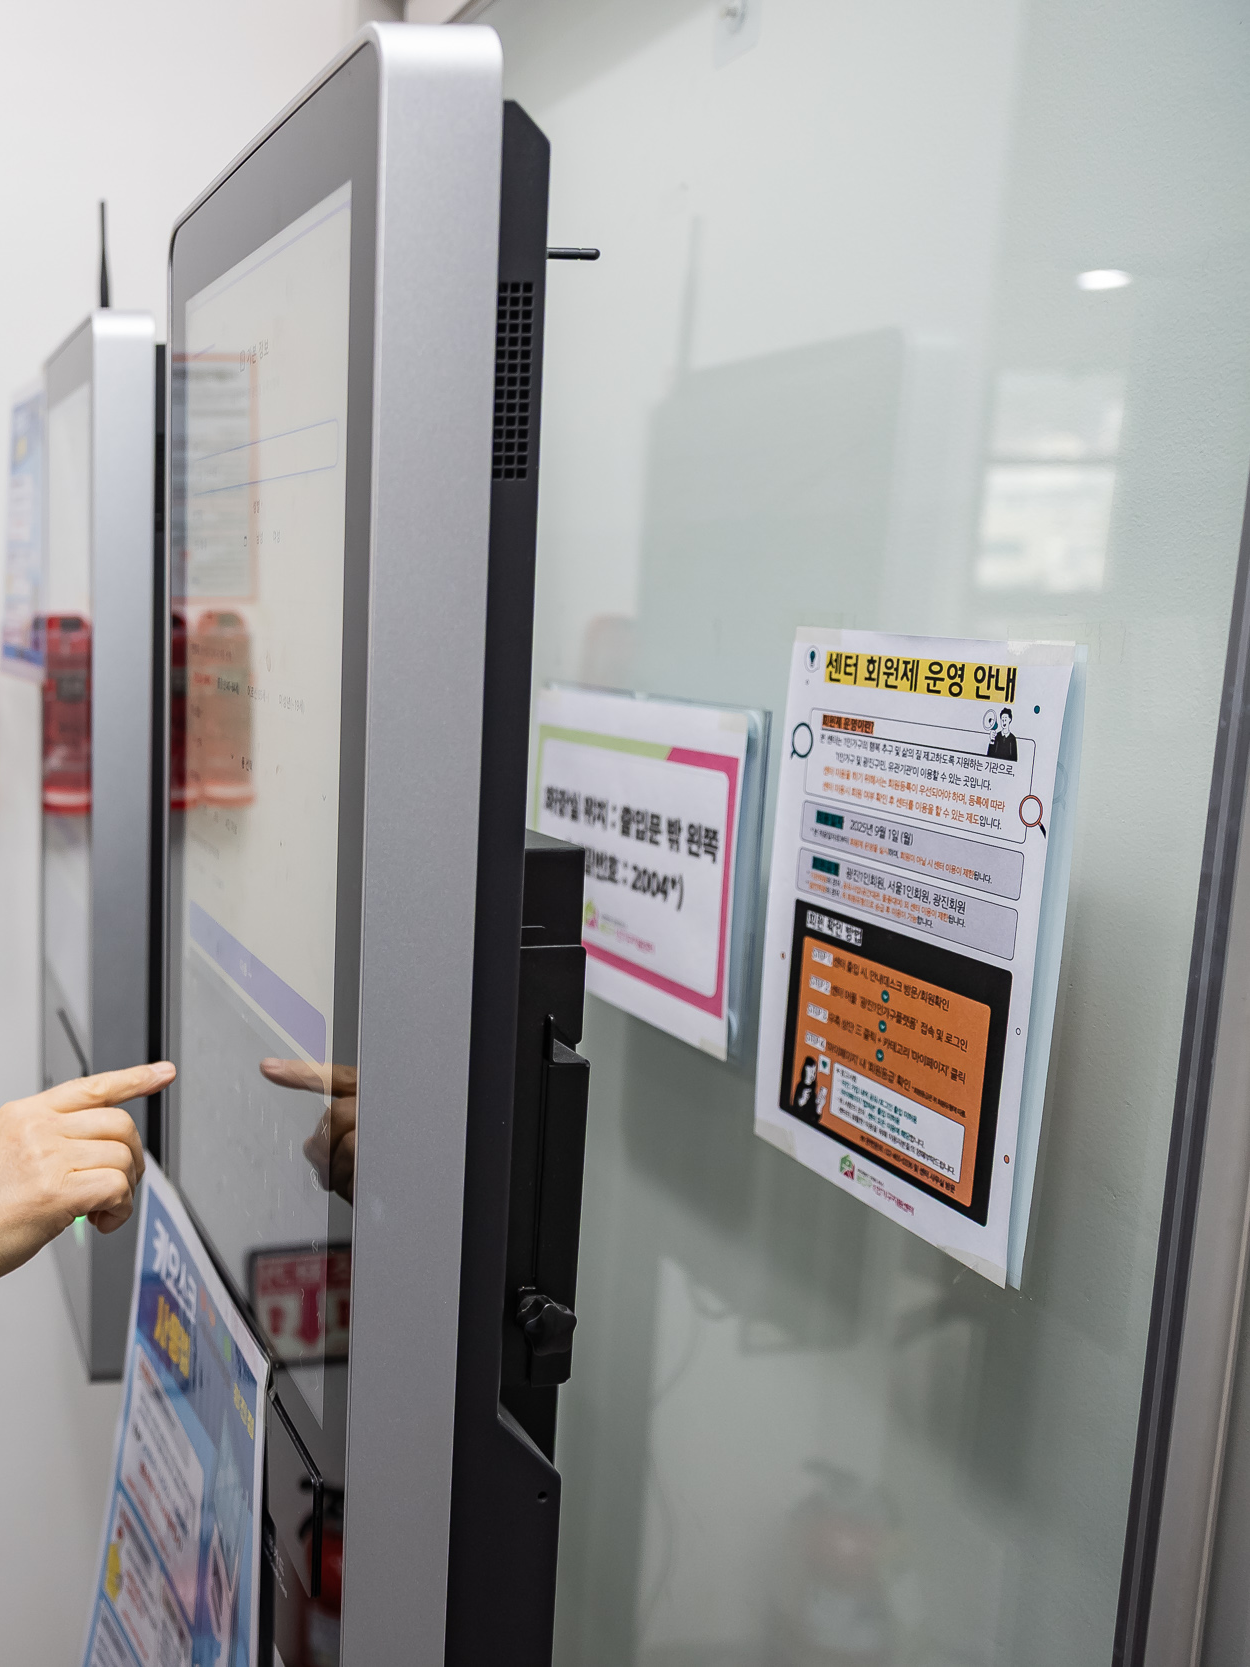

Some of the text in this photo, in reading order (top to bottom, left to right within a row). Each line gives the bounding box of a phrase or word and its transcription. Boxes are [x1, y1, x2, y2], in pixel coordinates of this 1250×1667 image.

[825, 651, 1017, 703] 센터 회원제 운영 안내
[855, 755, 861, 766] 및
[919, 767, 939, 781] 이용할
[939, 770, 947, 783] 수
[947, 772, 962, 786] 있는
[962, 774, 992, 792] 곳입니다.
[881, 743, 893, 755] 추구
[894, 745, 901, 757] 및
[901, 746, 914, 759] 삶의
[915, 748, 922, 760] 질
[922, 750, 955, 766] 제고하도록
[955, 755, 983, 771] 지원하는
[984, 760, 1015, 777] 기관으로,
[887, 777, 918, 794] 회원등록이
[918, 784, 951, 801] 우선되어야
[951, 790, 967, 805] 하며,
[967, 794, 989, 809] 등록에
[989, 798, 1005, 813] 따라
[584, 795, 609, 831] 위치
[620, 805, 662, 846] 출입문
[666, 816, 682, 852] 밖
[686, 822, 719, 863] 왼쪽
[895, 796, 914, 811] 센터를
[914, 800, 934, 815] 이용을
[934, 805, 941, 817] 할
[942, 806, 949, 819] 수
[950, 808, 964, 822] 있는
[965, 811, 1002, 831] 제도입니다.
[849, 818, 873, 836] 2025년
[873, 824, 886, 840] 9월
[887, 828, 899, 843] 1일
[900, 831, 913, 847] (월)
[845, 865, 886, 891] 광진1인회원,
[887, 878, 931, 905] 서울1인회원,
[932, 891, 966, 915] 광진회원
[933, 859, 944, 872] 센터
[945, 863, 962, 876] 이용이
[962, 867, 992, 885] 제한됩니다.
[869, 969, 902, 992] 안내데스크
[903, 982, 949, 1011] 방문/회원확인
[920, 1020, 934, 1038] 접속
[935, 1027, 944, 1042] 및
[944, 1030, 967, 1052] 로그인
[883, 1036, 909, 1059] 카테고리
[949, 1066, 965, 1084] 클릭
[896, 1074, 911, 1092] 확인
